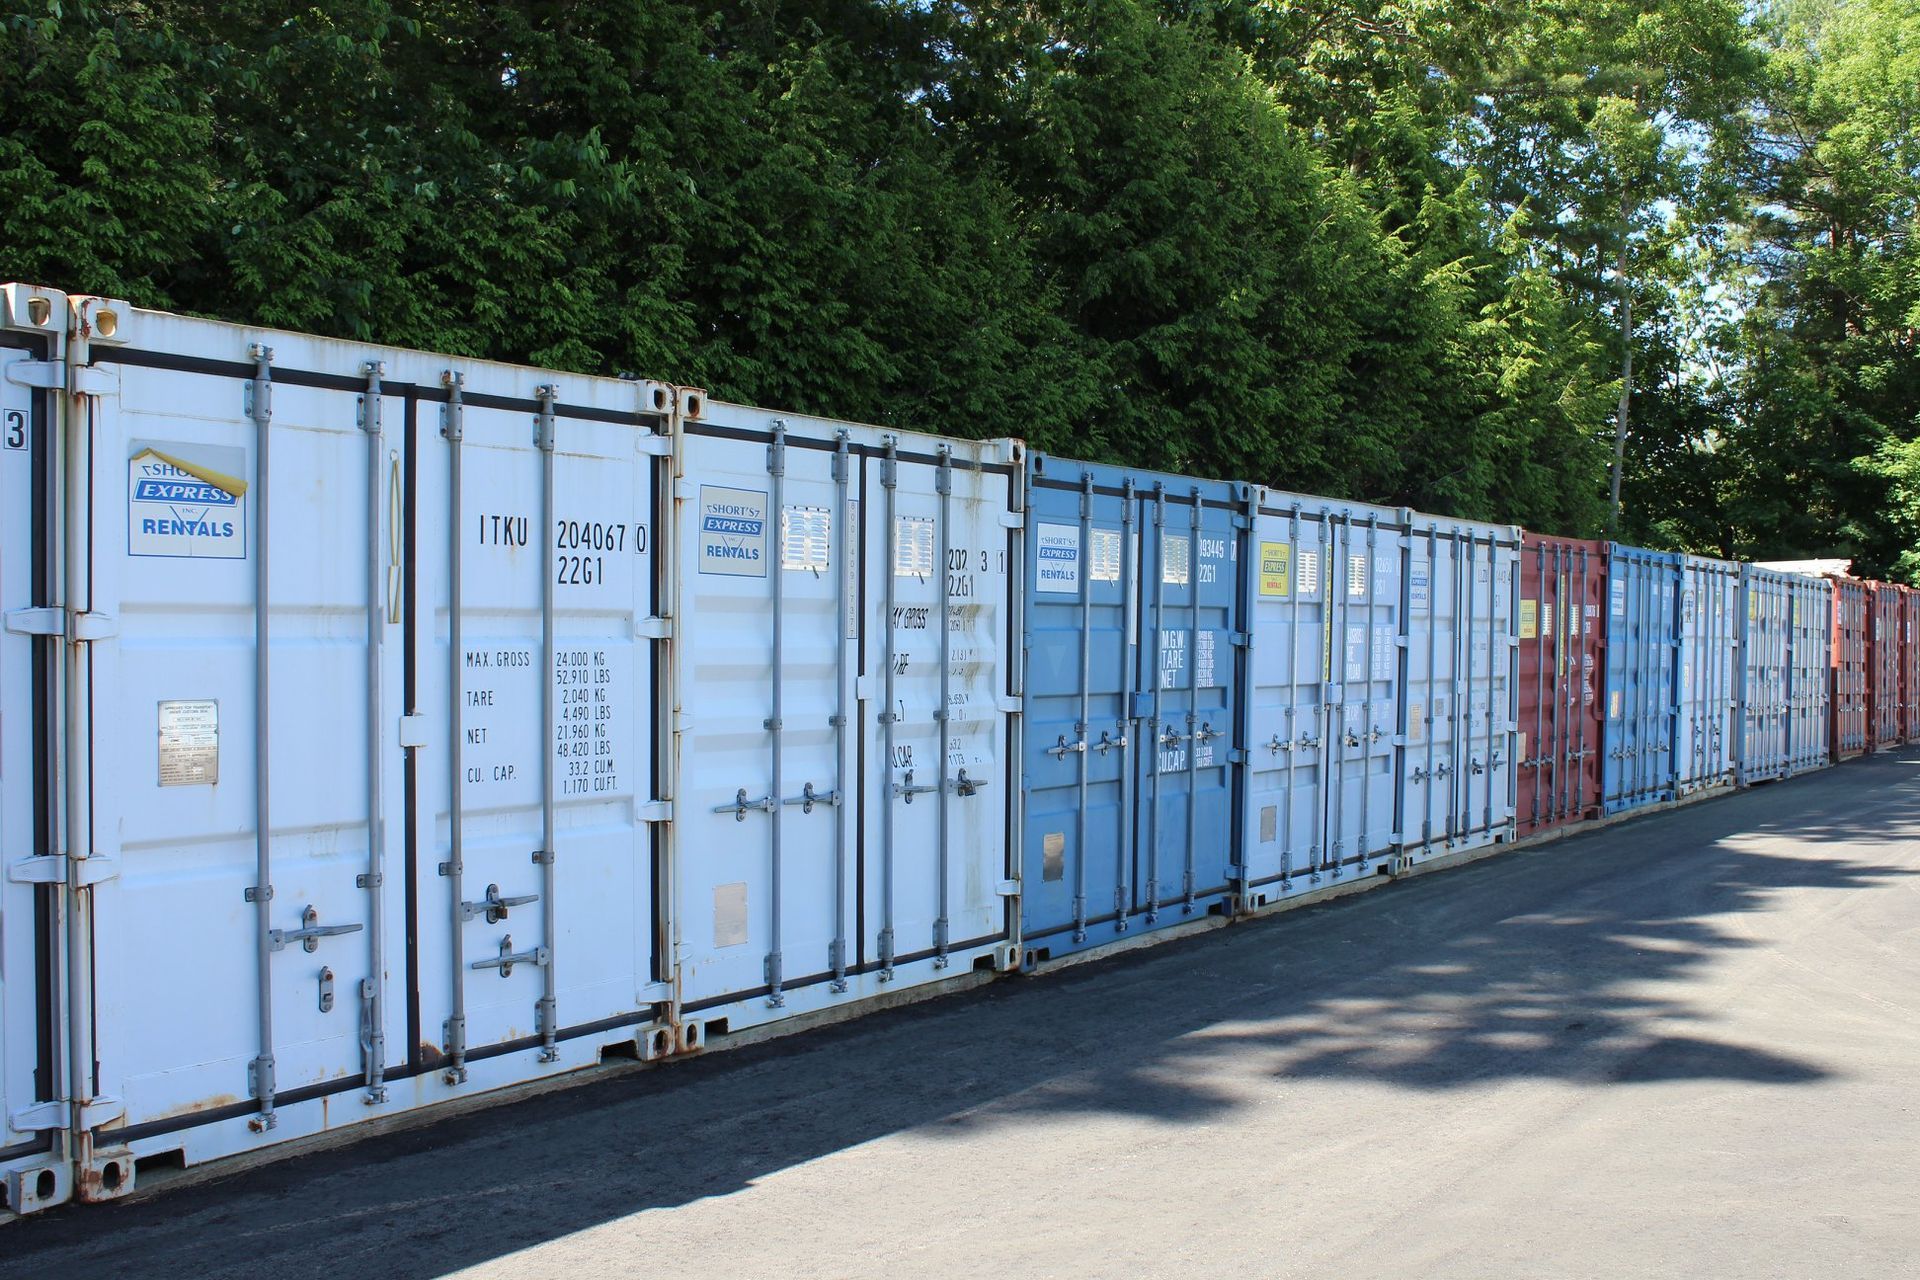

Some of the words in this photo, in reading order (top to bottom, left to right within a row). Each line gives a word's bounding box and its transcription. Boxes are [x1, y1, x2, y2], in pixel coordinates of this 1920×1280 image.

[8, 412, 24, 447] 3
[153, 464, 193, 478] SHO
[142, 484, 233, 502] EXPRESS
[712, 504, 755, 517] SHORT'S
[143, 519, 234, 537] RENTALS
[480, 515, 527, 546] ITKU
[557, 520, 625, 551] 204067
[637, 526, 646, 552] 0
[706, 519, 759, 532] EXPRESS
[706, 545, 759, 560] RENTALS
[1041, 549, 1075, 559] EXPRESS
[558, 556, 602, 585] 22G1
[1041, 570, 1075, 580] RENTALS
[557, 652, 588, 667] 24.000
[594, 652, 605, 666] KG
[1161, 650, 1183, 669] TARE
[557, 670, 588, 684] 52.910
[594, 669, 610, 684] LBS
[1161, 670, 1177, 689] NET
[467, 691, 494, 706] TARE
[563, 689, 589, 703] 2.040
[595, 688, 606, 702] KG
[563, 706, 589, 721] 4.490
[595, 706, 611, 720] LBS
[468, 728, 487, 744] NET
[557, 725, 589, 740] 21.960
[595, 724, 606, 738] KG
[557, 743, 589, 757] 48.420
[595, 741, 611, 755] LBS
[494, 765, 516, 781] CAP.
[569, 761, 588, 776] 33.2
